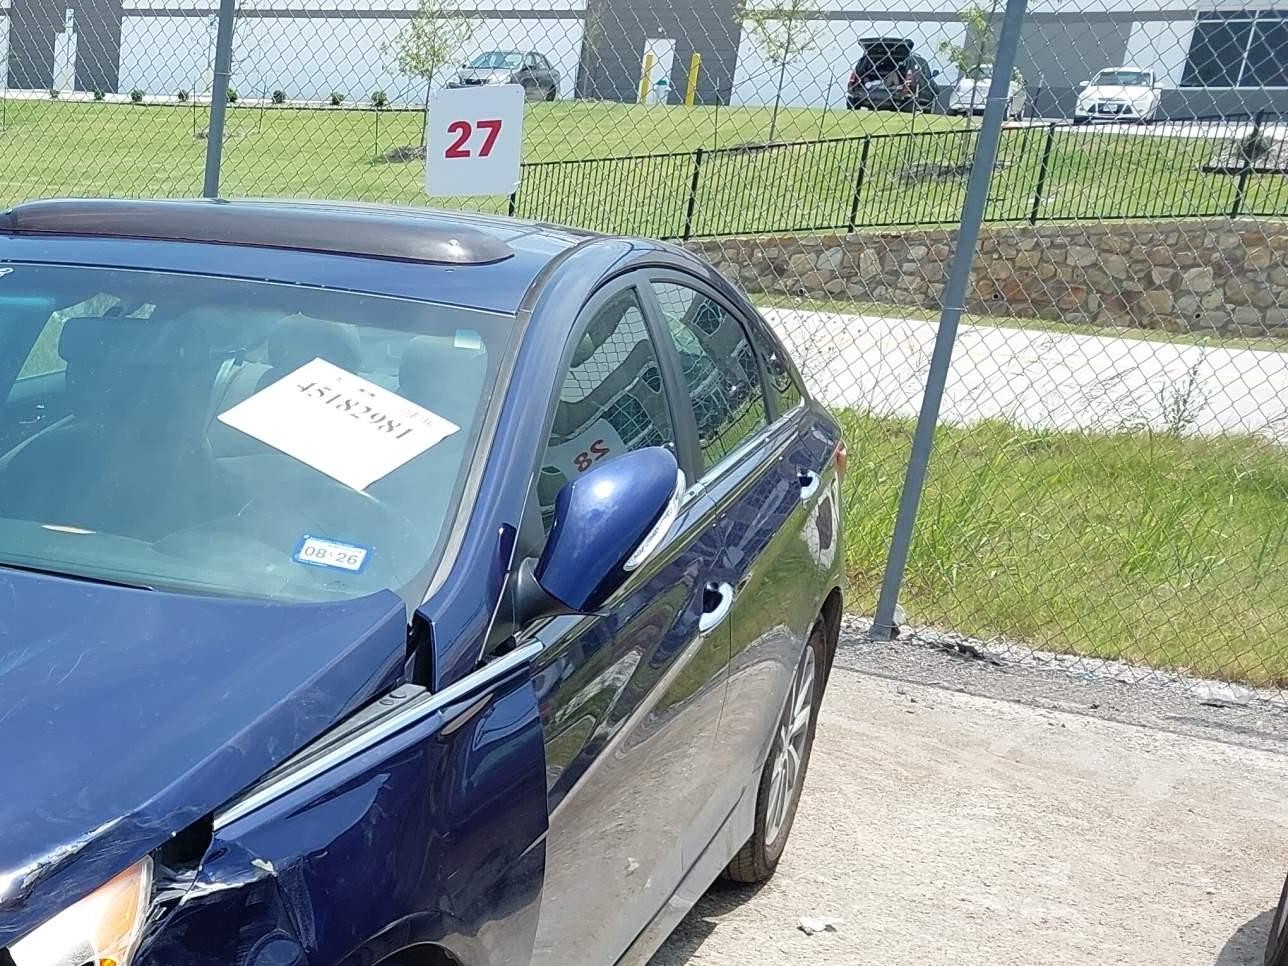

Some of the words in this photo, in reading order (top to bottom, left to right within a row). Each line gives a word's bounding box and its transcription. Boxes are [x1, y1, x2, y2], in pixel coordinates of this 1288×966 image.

[444, 119, 503, 159] 27
[295, 381, 414, 440] 45182981
[304, 546, 327, 559] 08
[335, 551, 359, 565] 26
